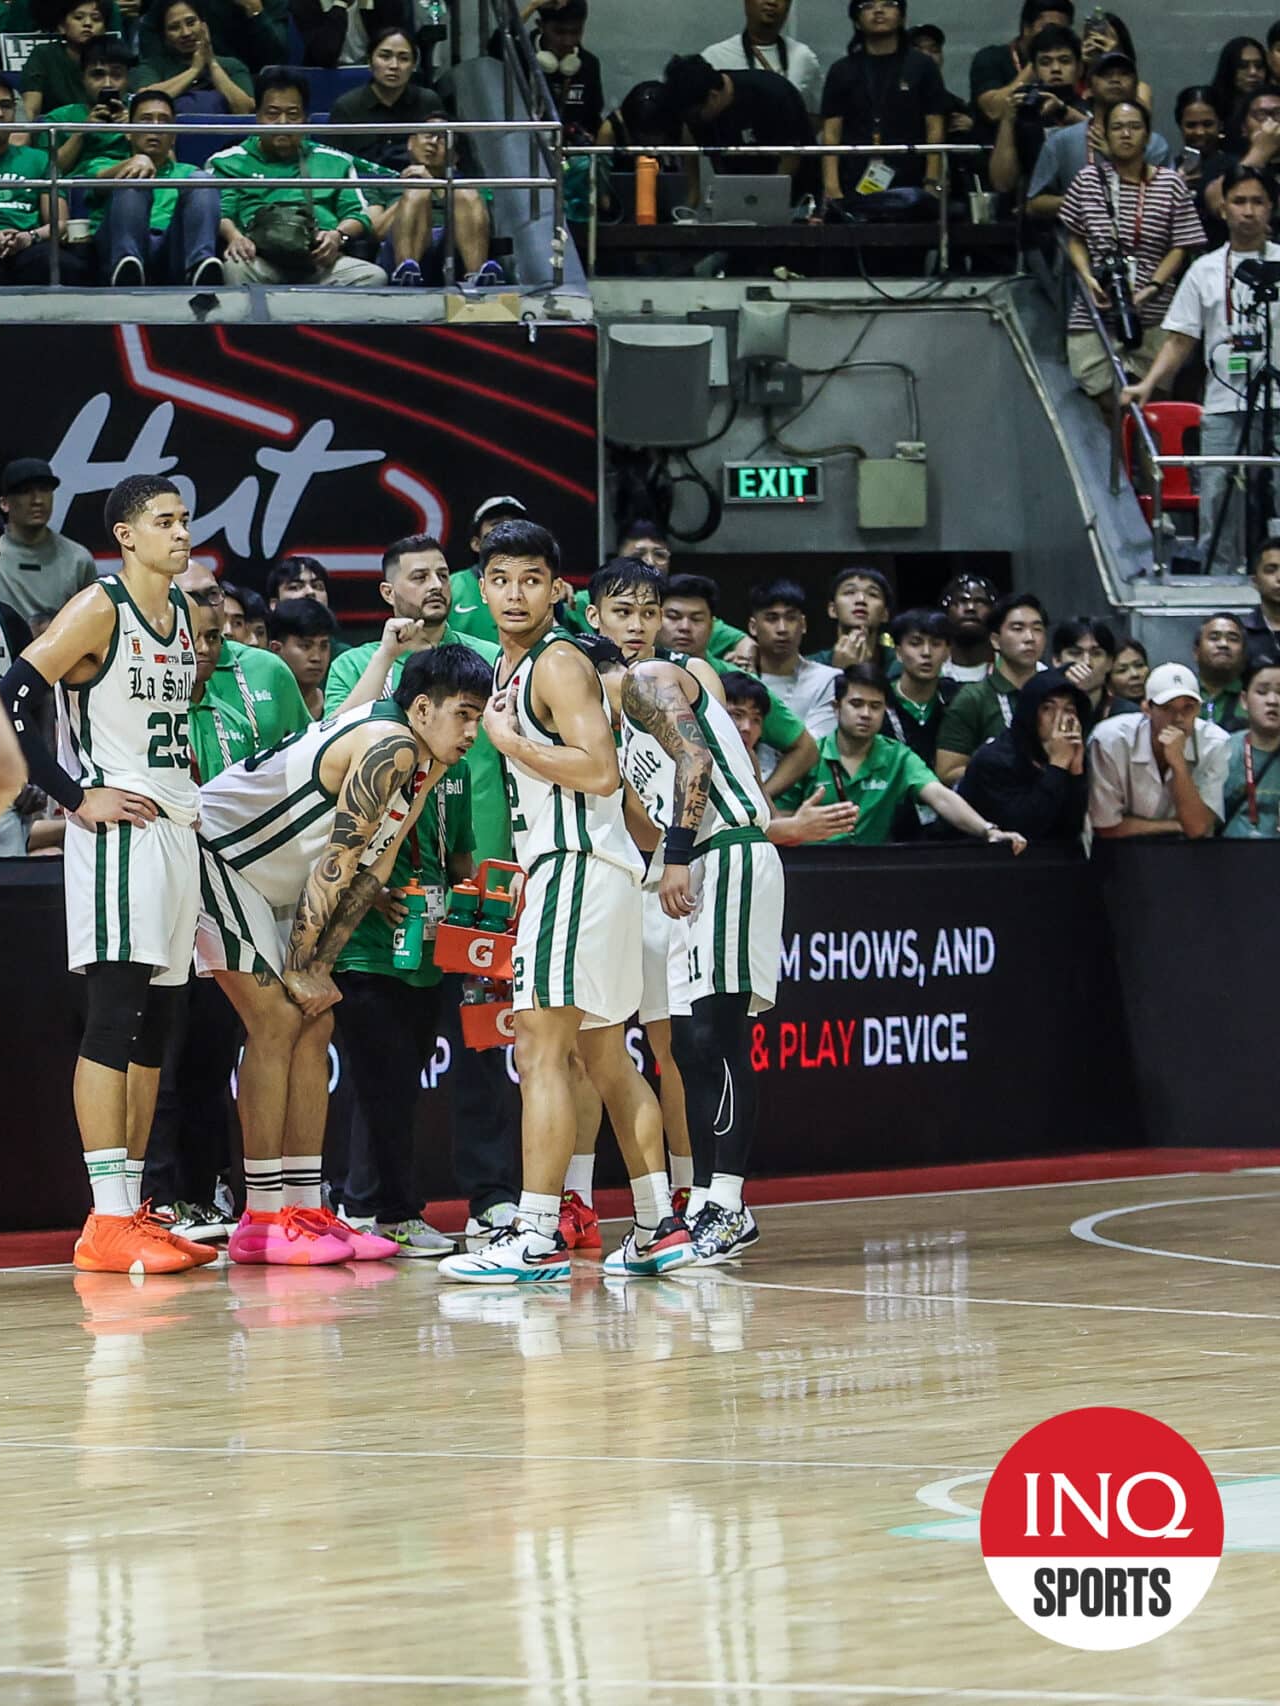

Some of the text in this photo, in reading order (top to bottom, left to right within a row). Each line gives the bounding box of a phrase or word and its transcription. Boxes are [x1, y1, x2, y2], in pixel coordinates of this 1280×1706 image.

[48, 391, 387, 559] Hut
[738, 468, 809, 497] EXIT
[128, 667, 197, 702] La Sall
[147, 712, 192, 769] 25
[468, 937, 495, 968] G
[809, 928, 926, 988] SHOWS,
[931, 926, 996, 977] AND
[749, 1012, 969, 1073] & PLAY DEVICE
